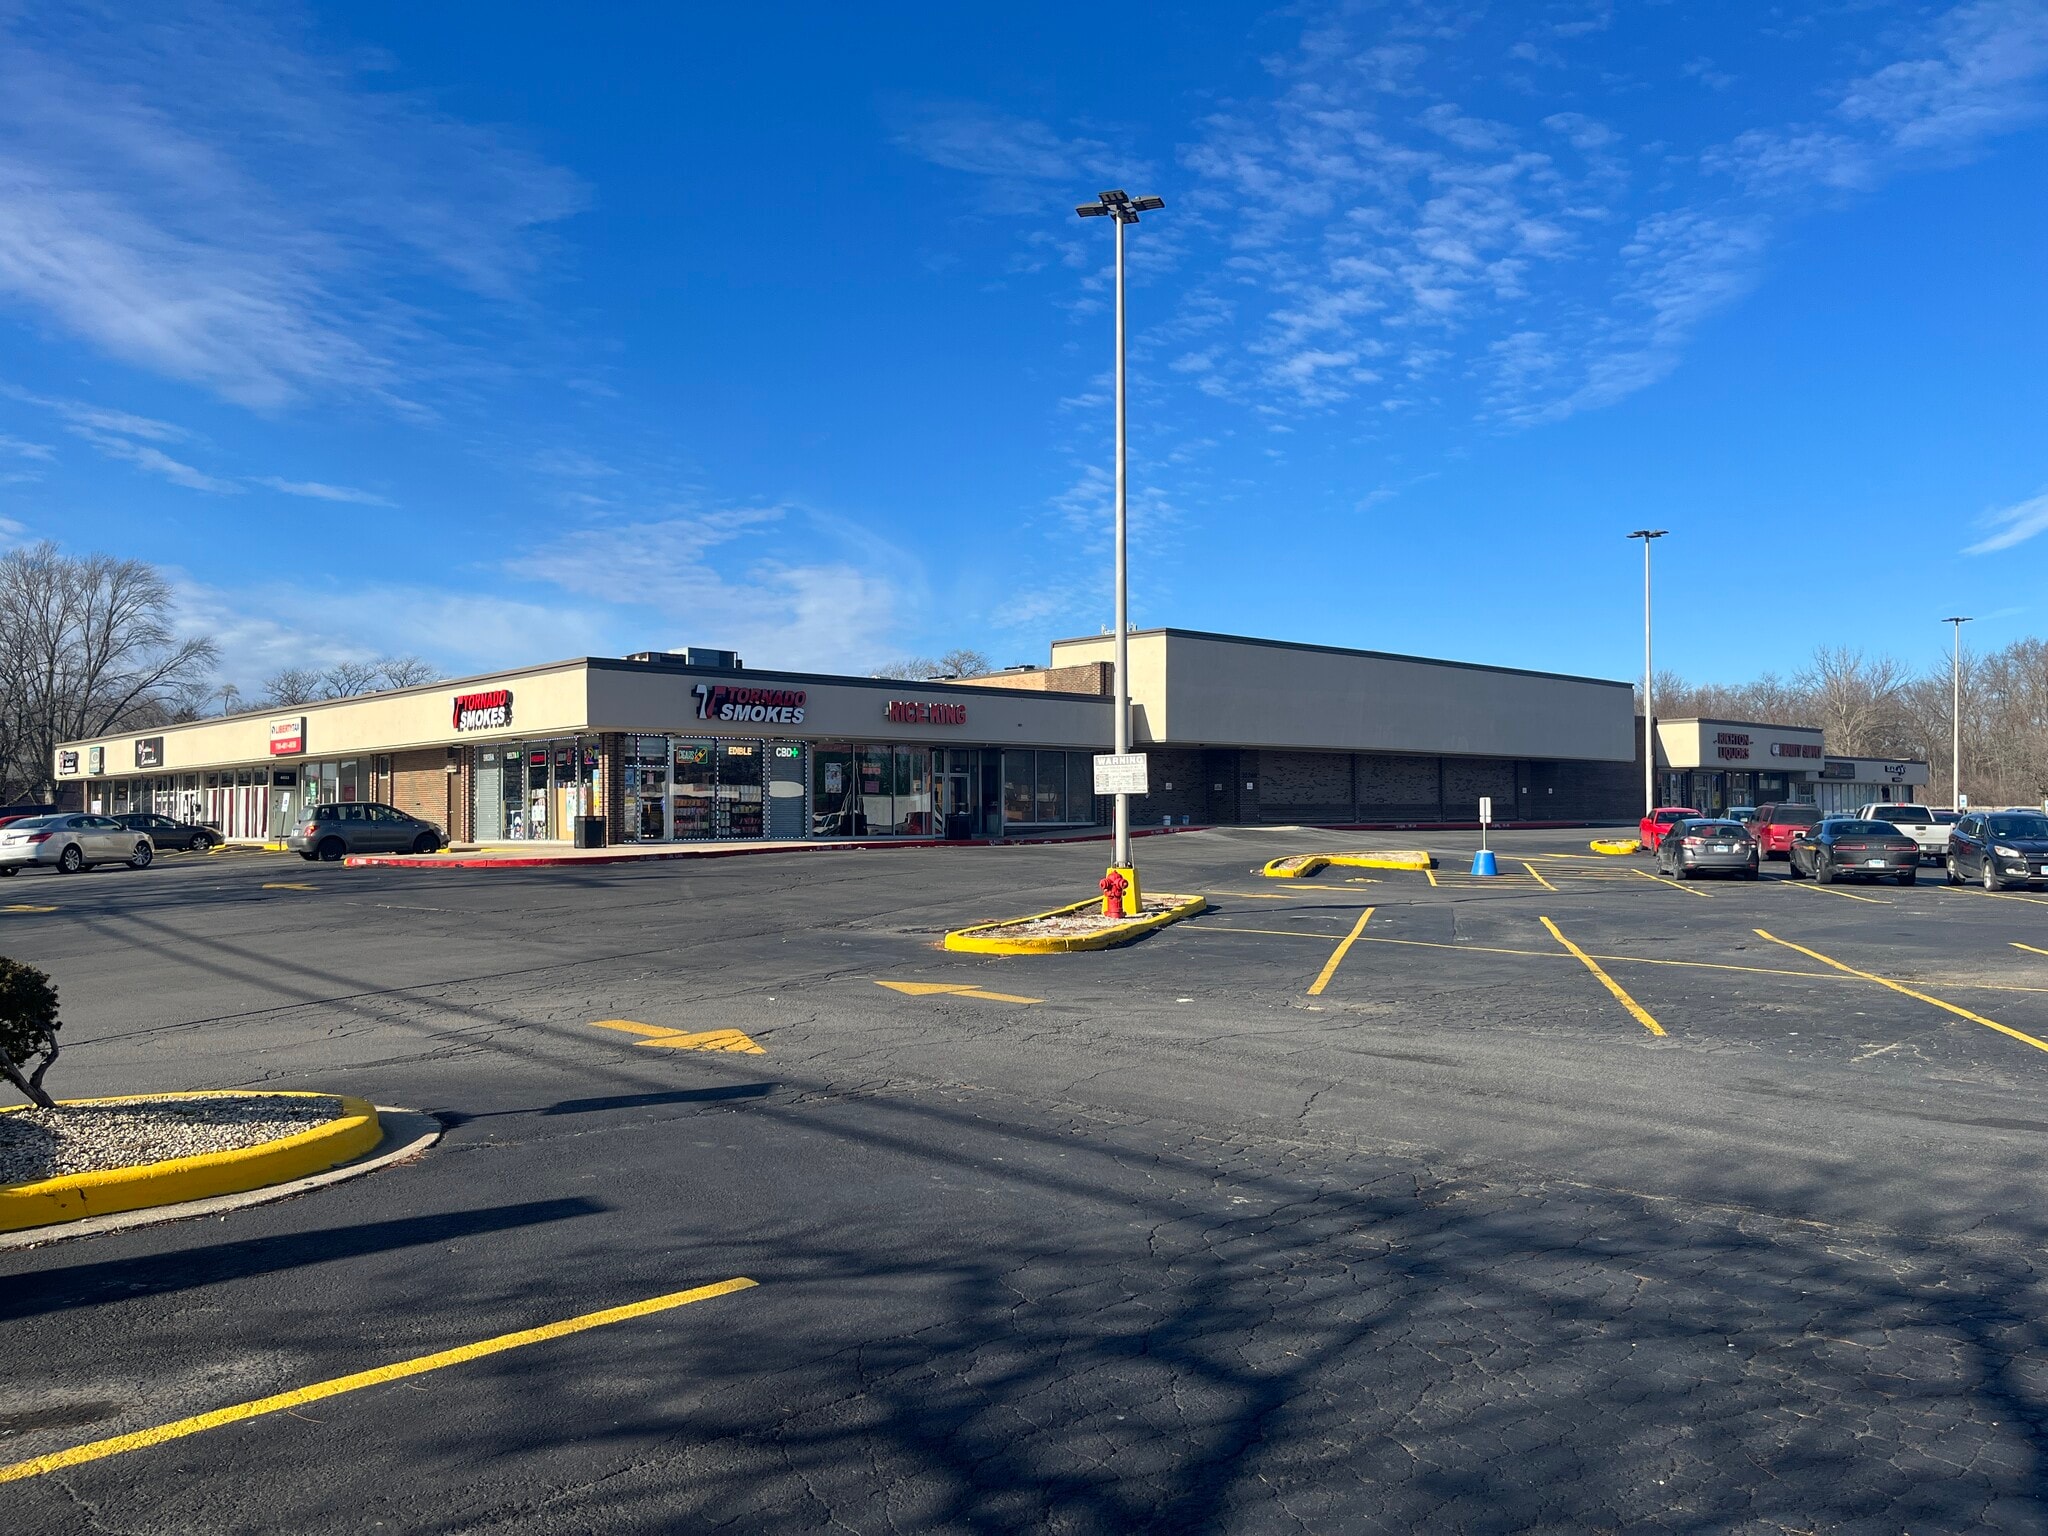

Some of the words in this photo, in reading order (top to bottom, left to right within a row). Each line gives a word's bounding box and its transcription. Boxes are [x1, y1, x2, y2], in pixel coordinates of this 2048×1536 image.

[463, 689, 507, 711] TORNADO
[727, 686, 807, 708] TORNADO
[460, 706, 506, 729] SMOKES
[720, 703, 805, 724] SMOKES
[888, 701, 926, 723] RICE
[929, 703, 967, 725] KING
[1717, 732, 1750, 746] RICHTON
[727, 746, 753, 756] EDIBLE
[1096, 756, 1144, 766] WARNING
[1717, 746, 1750, 761] LIQUORS
